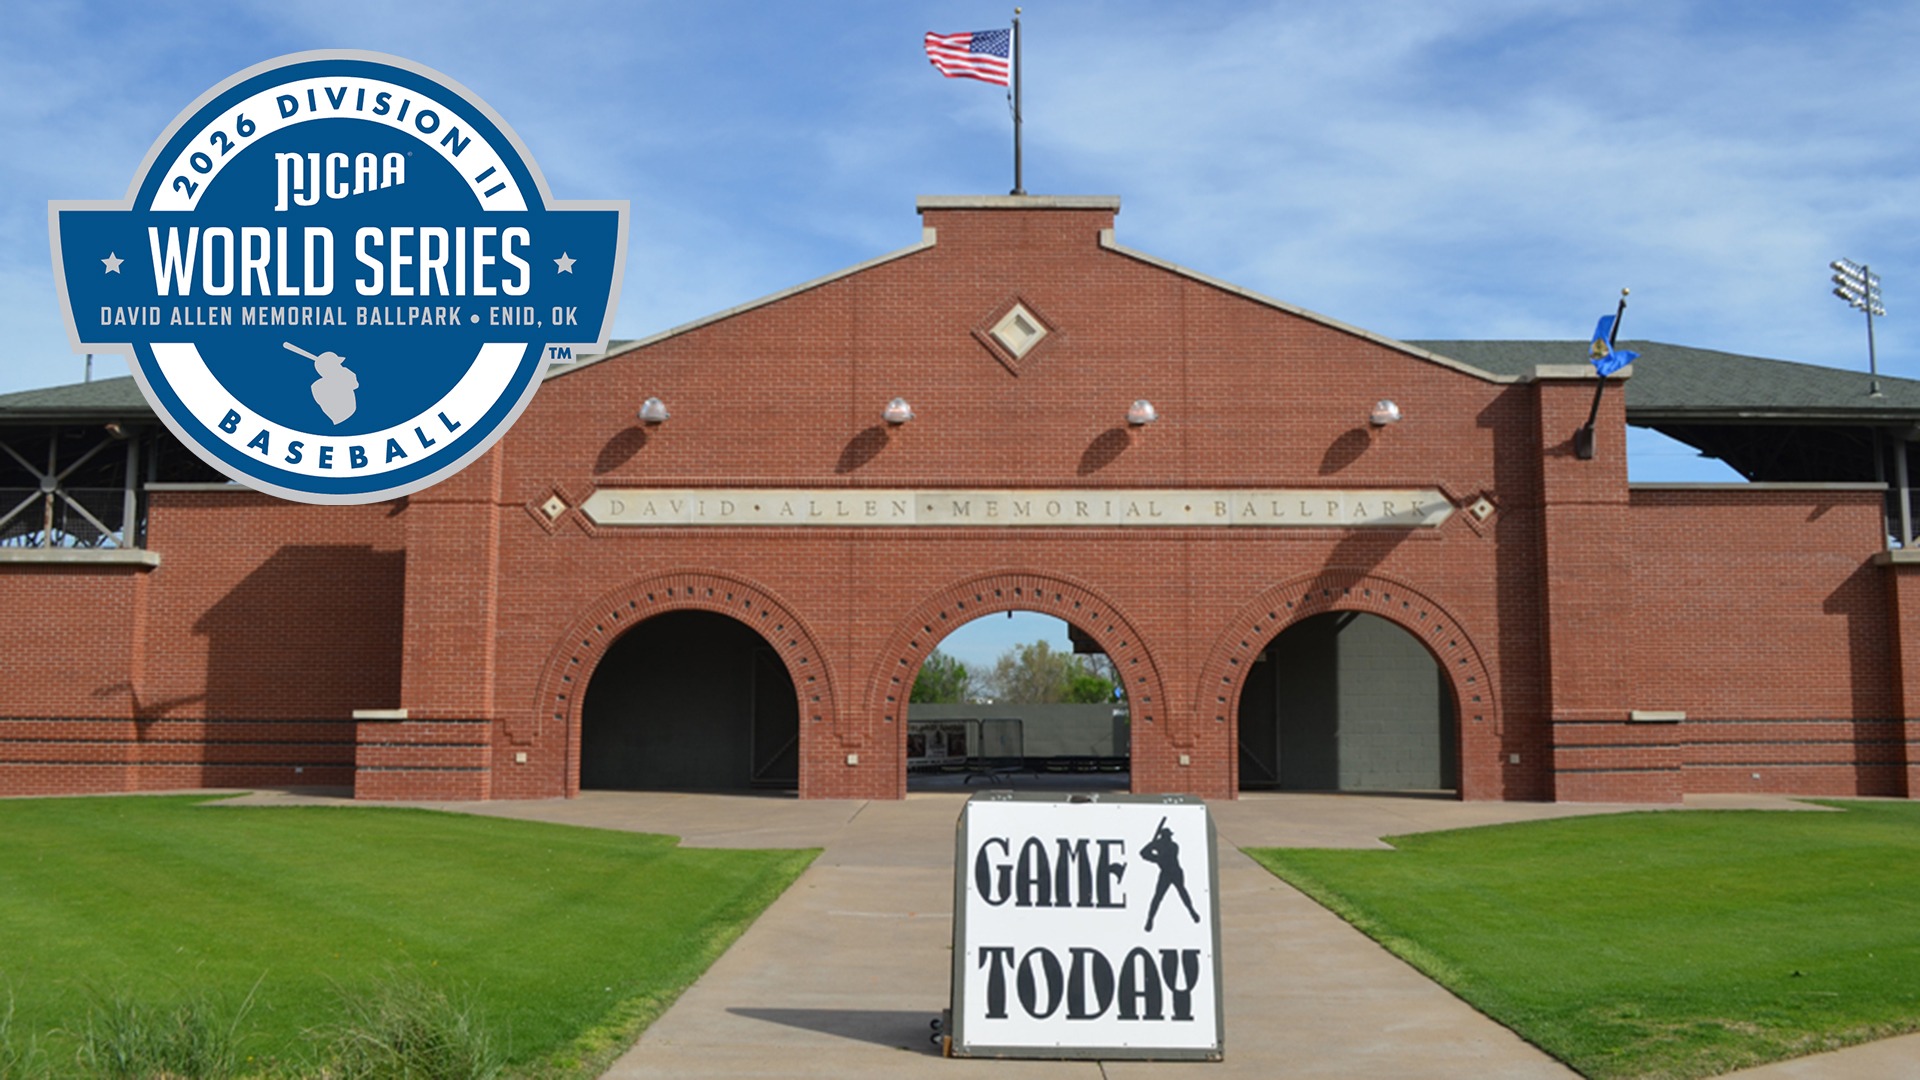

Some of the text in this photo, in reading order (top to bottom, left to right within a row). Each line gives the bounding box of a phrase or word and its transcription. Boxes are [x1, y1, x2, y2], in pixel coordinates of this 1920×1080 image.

[610, 500, 1426, 518] DAVID ALLEN MEMORIAL BALLPARK
[975, 836, 1127, 909] GAME
[978, 946, 1201, 1021] TODAY
